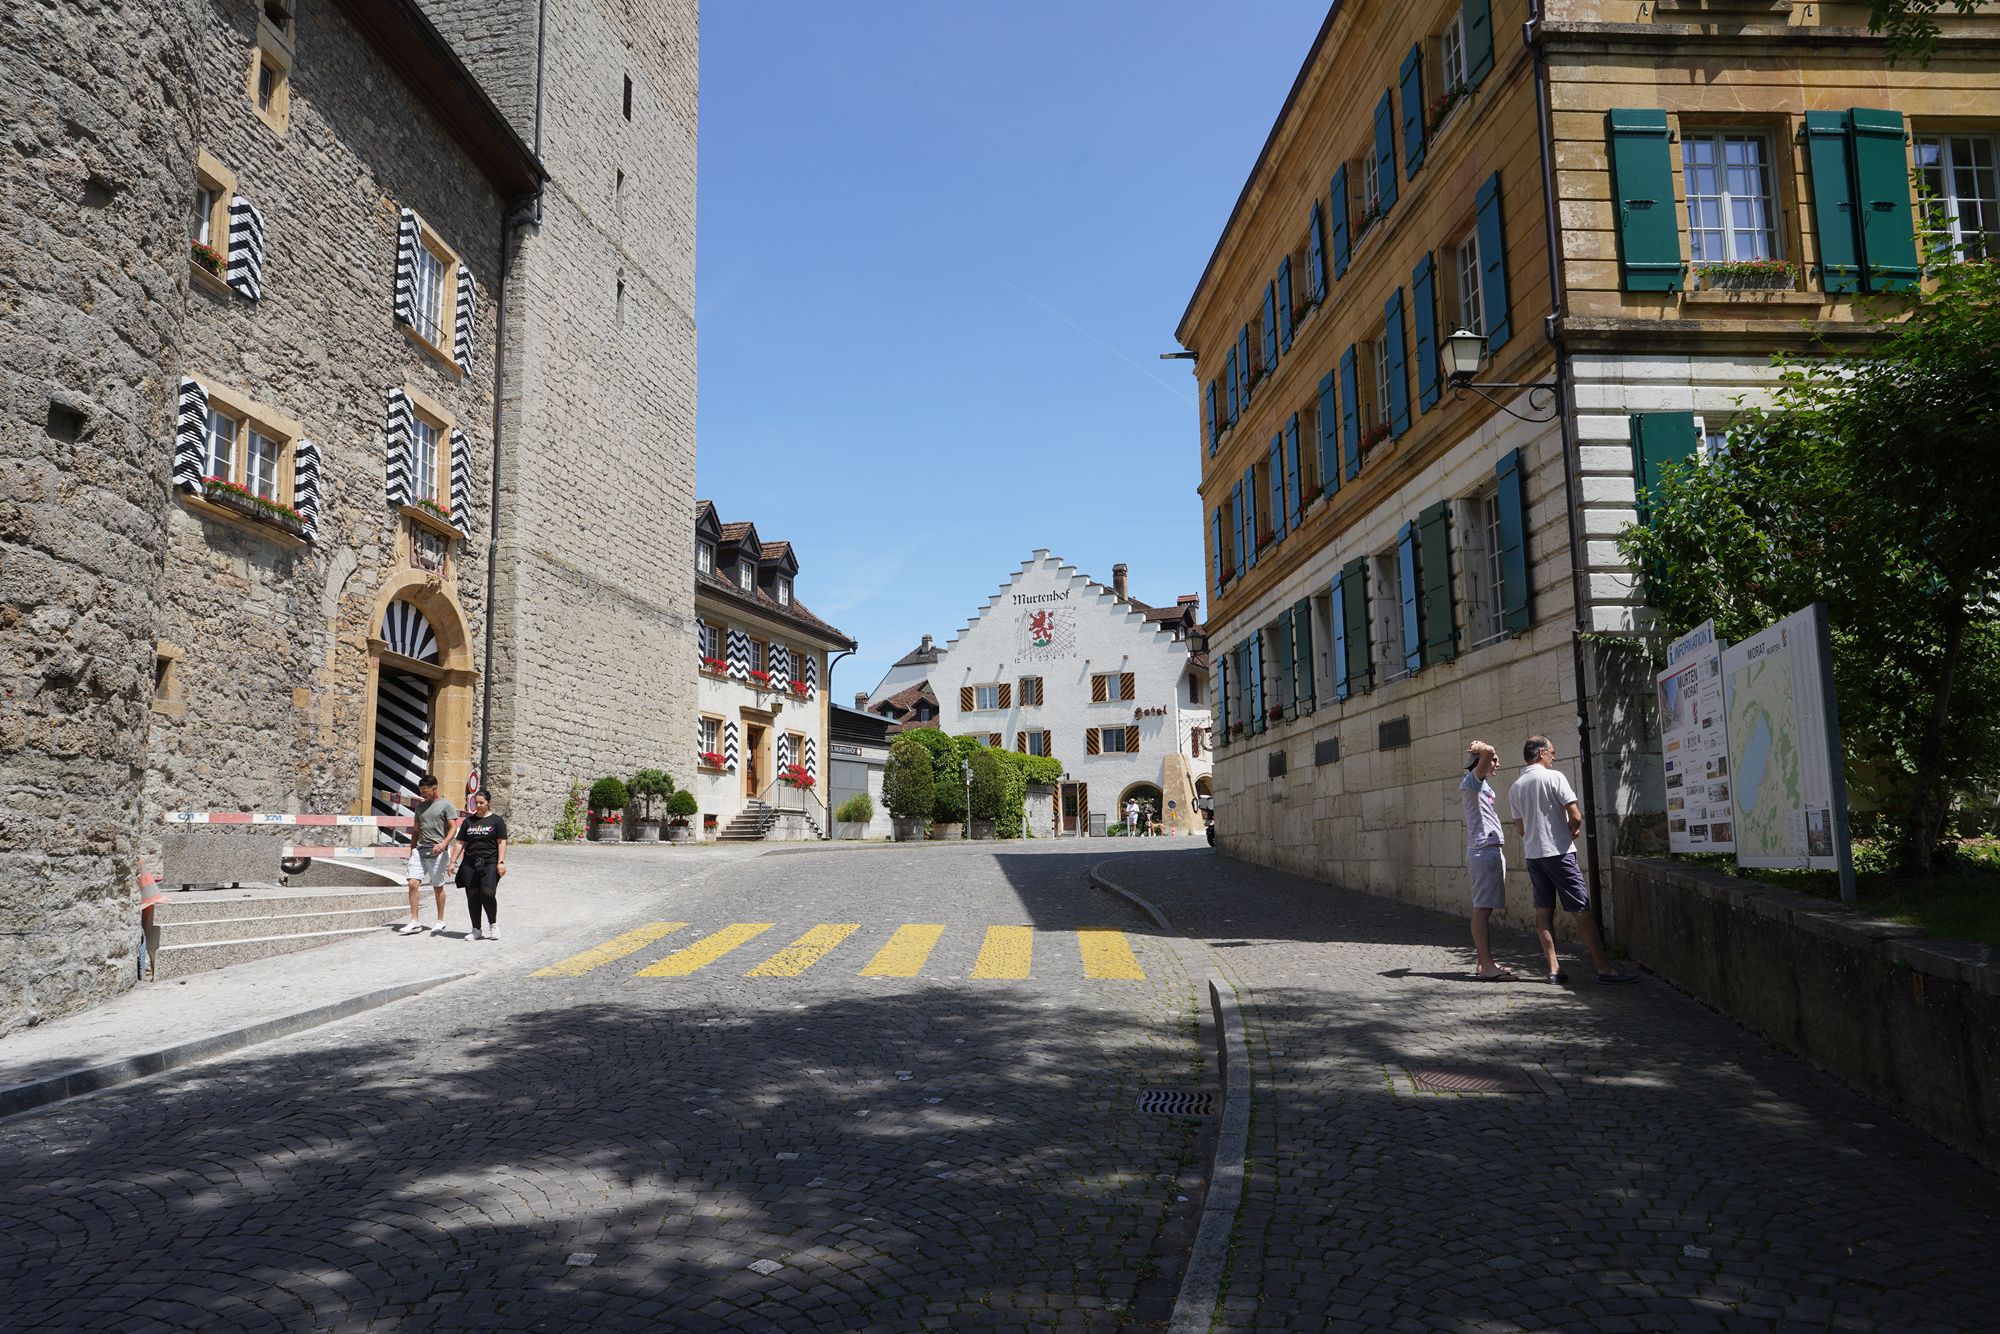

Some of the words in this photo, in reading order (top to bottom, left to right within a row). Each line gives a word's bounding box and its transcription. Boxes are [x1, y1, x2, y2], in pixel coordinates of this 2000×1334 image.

[1012, 588, 1071, 605] Murtenhof
[1674, 629, 1707, 660] INFORMATION
[1747, 642, 1765, 660] MORAT
[1677, 668, 1698, 689] MURTEN
[1683, 682, 1699, 700] MORAT
